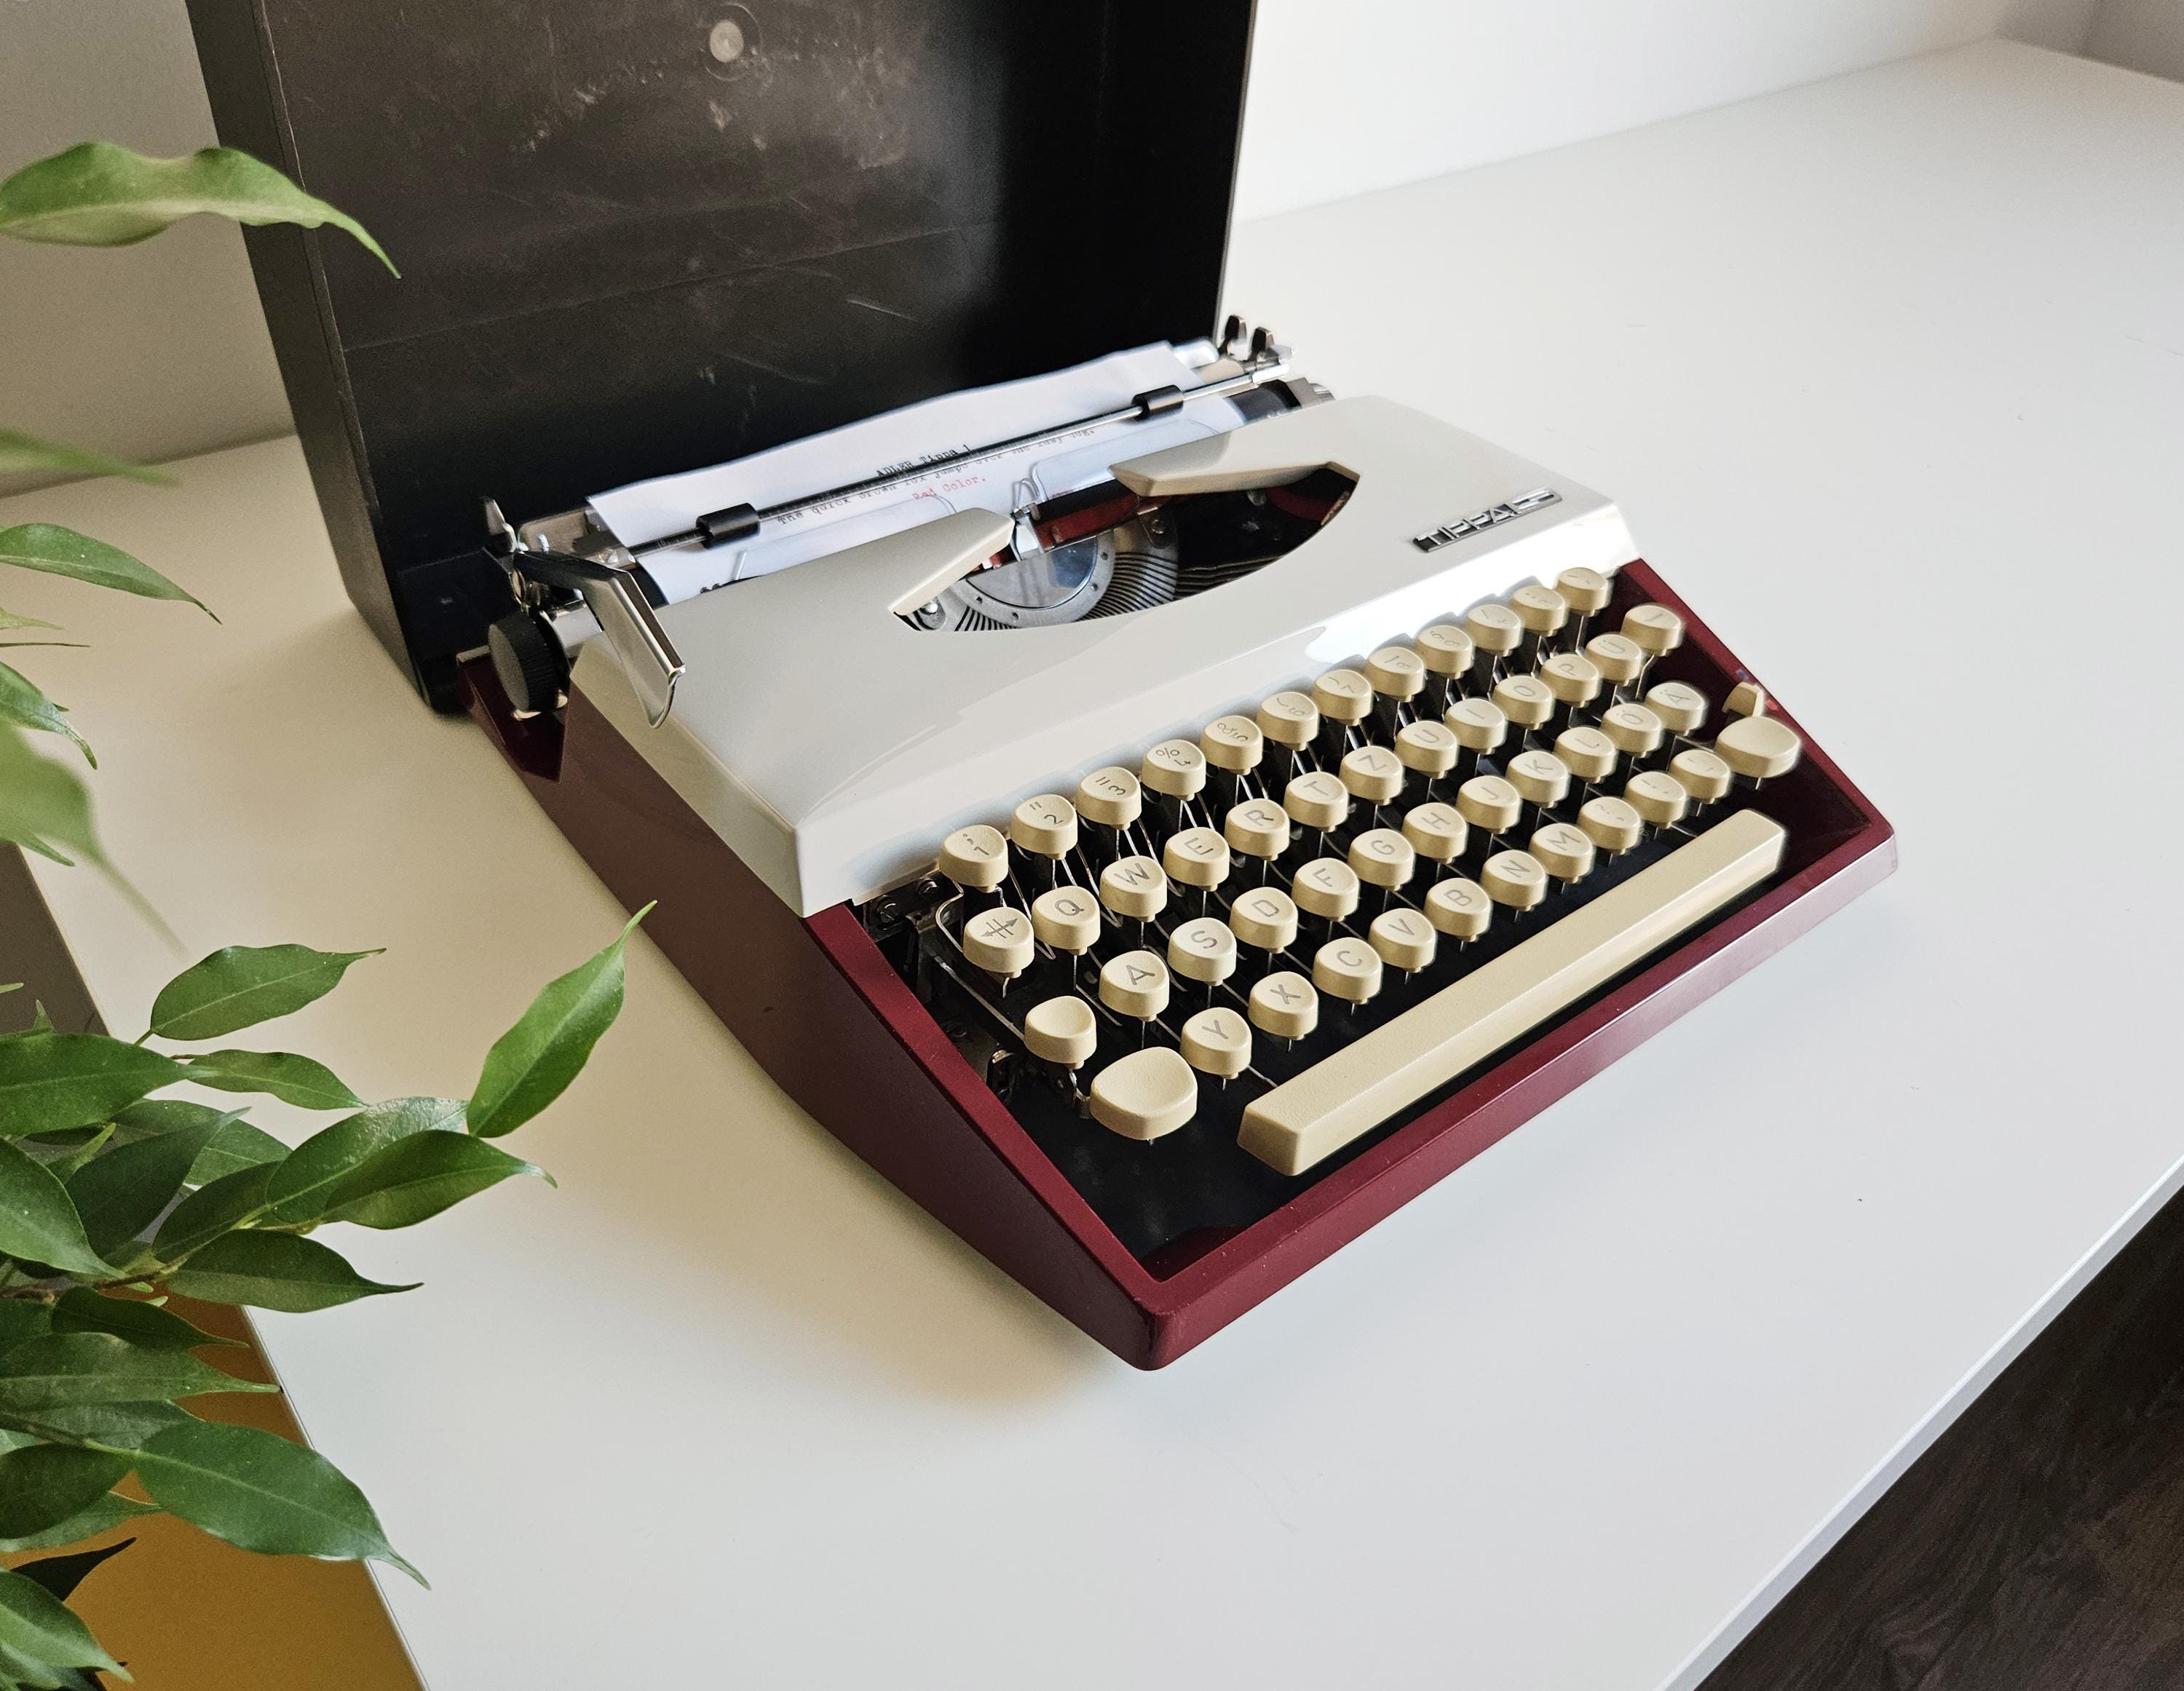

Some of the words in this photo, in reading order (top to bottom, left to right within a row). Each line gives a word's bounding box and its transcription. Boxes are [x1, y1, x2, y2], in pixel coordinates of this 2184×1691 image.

[876, 461, 915, 477] ADLER
[942, 475, 986, 492] Color.
[1598, 640, 1626, 654] Ü
[1396, 662, 1411, 670] 8
[1556, 663, 1575, 676] P
[1340, 684, 1356, 694] 7
[1513, 685, 1535, 697] O
[1659, 689, 1691, 705] Ä
[1288, 708, 1305, 717] 6
[1465, 708, 1485, 720] I
[1616, 710, 1644, 725] Ö
[1232, 732, 1249, 742] 5
[1413, 729, 1440, 743] U
[1574, 737, 1600, 749] L
[1358, 754, 1387, 772] Z
[1524, 759, 1554, 775] K
[1108, 785, 1125, 796] 3
[1303, 780, 1329, 796] T
[1480, 786, 1500, 801] J
[1043, 814, 1064, 825] 2
[1243, 809, 1274, 827] R
[1421, 812, 1452, 830] H
[1184, 837, 1214, 856] E
[1370, 840, 1396, 855] G
[1546, 830, 1581, 851] M
[973, 846, 990, 856] 1
[1114, 863, 1150, 886] W
[1312, 867, 1334, 887] F
[1500, 859, 1531, 879] N
[1444, 889, 1473, 907] B
[1055, 899, 1085, 916] Q
[1251, 900, 1280, 918] D
[1388, 918, 1415, 936] V
[1190, 930, 1218, 949] S
[1337, 950, 1363, 967] C
[1125, 965, 1155, 986] A
[1270, 983, 1301, 1005] X
[1201, 1019, 1229, 1039] Y
